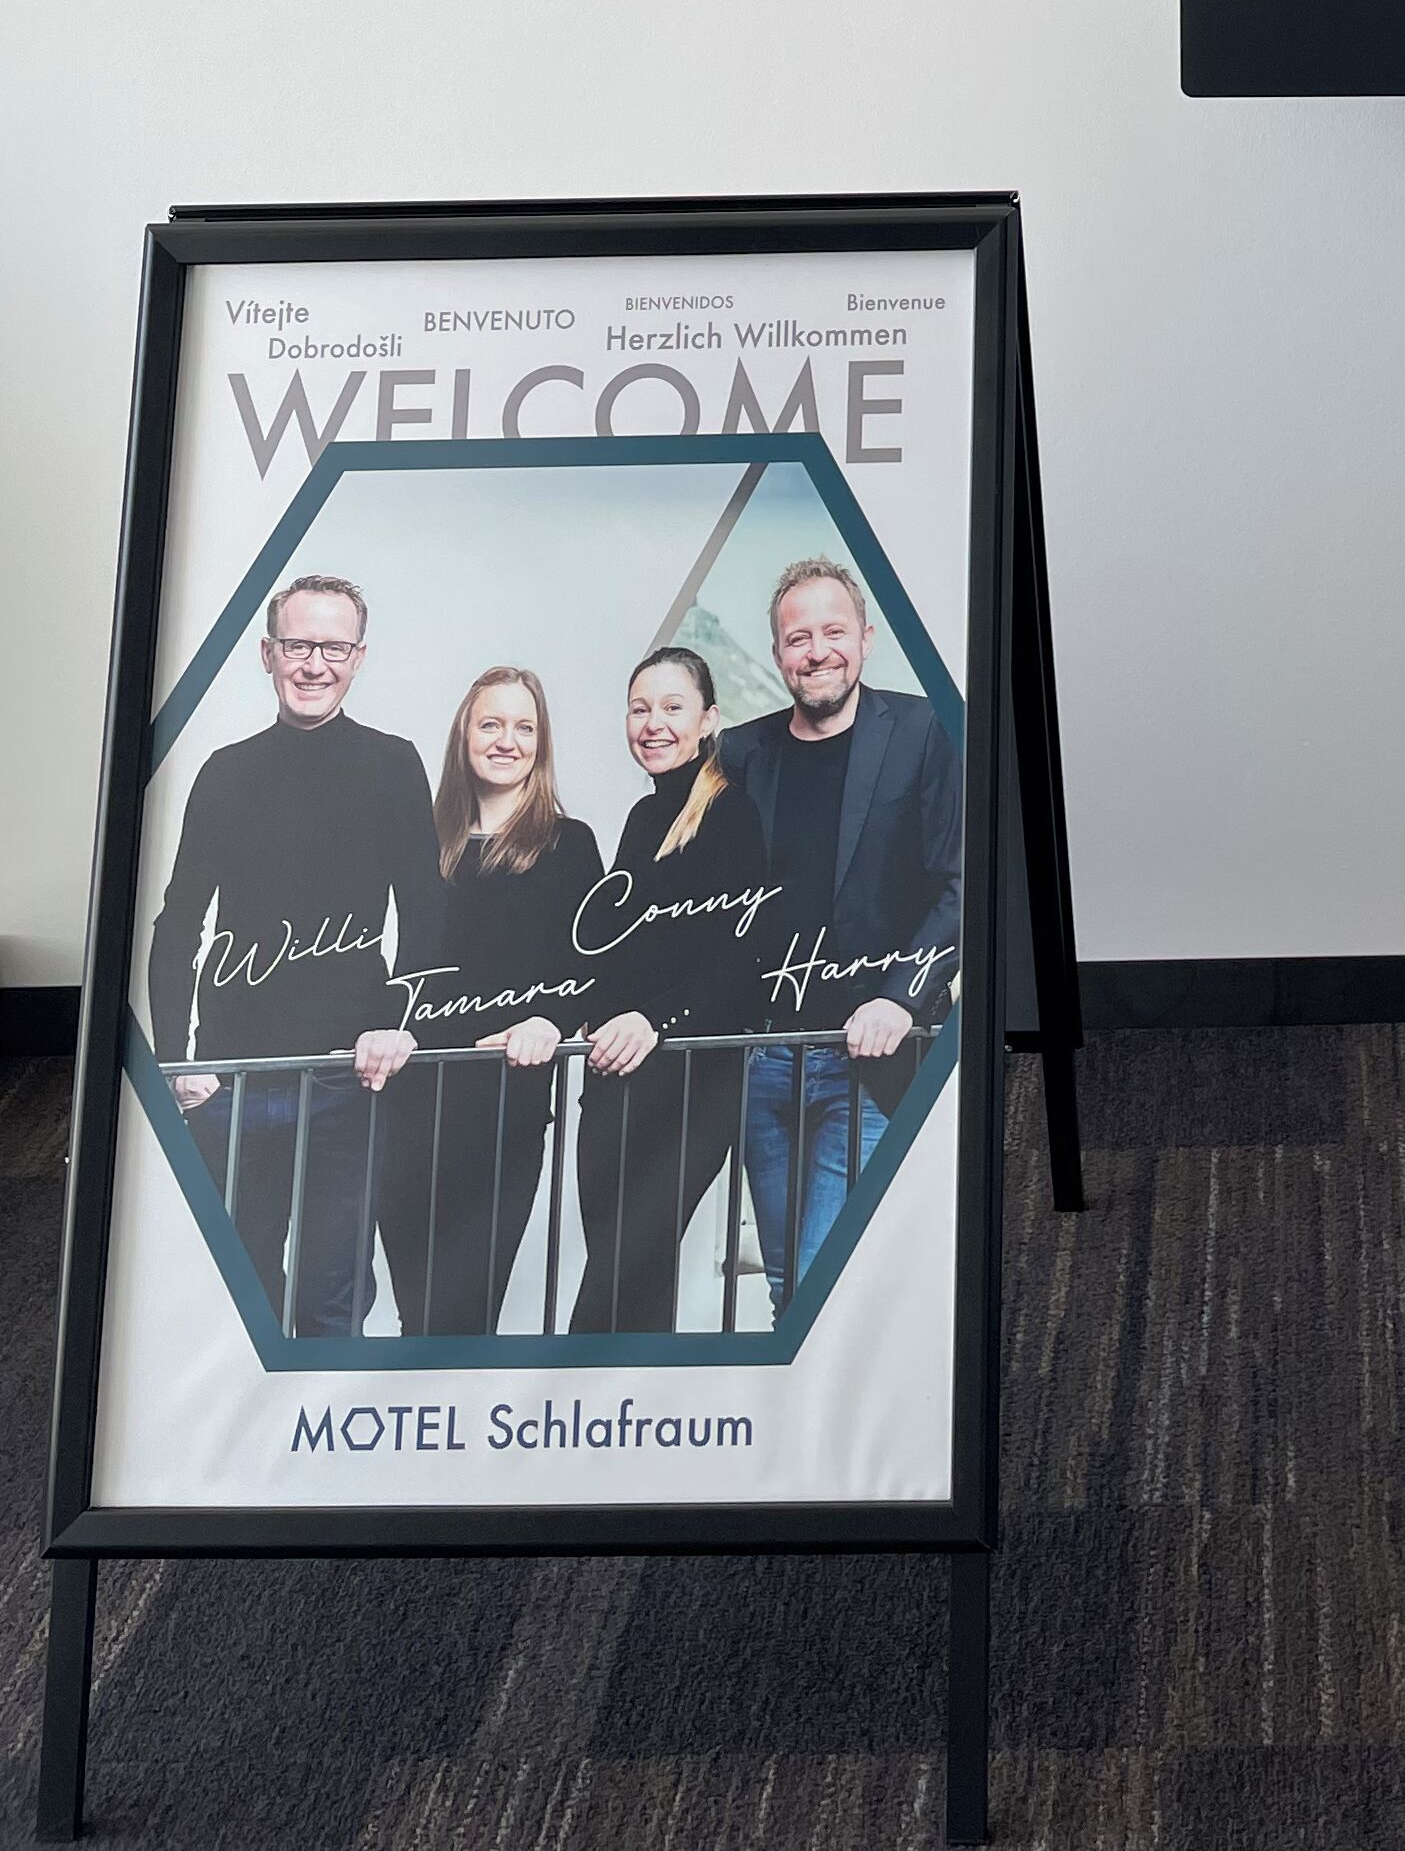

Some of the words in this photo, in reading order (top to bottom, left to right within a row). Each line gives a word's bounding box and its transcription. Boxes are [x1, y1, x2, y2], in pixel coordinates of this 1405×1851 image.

[226, 299, 310, 330] Vítejte
[626, 296, 733, 310] BIENVENIDOS
[848, 294, 945, 311] Bienvenue
[424, 309, 575, 331] BENVENUTO
[607, 322, 721, 350] Herzlich
[734, 320, 906, 348] Willkommen
[269, 334, 402, 359] Dobrodošli
[572, 870, 783, 955] Conny
[761, 927, 955, 1011] Harry
[386, 966, 595, 1031] Tamara
[291, 1406, 465, 1452] MOTEL
[488, 1399, 752, 1449] Schlafraum
